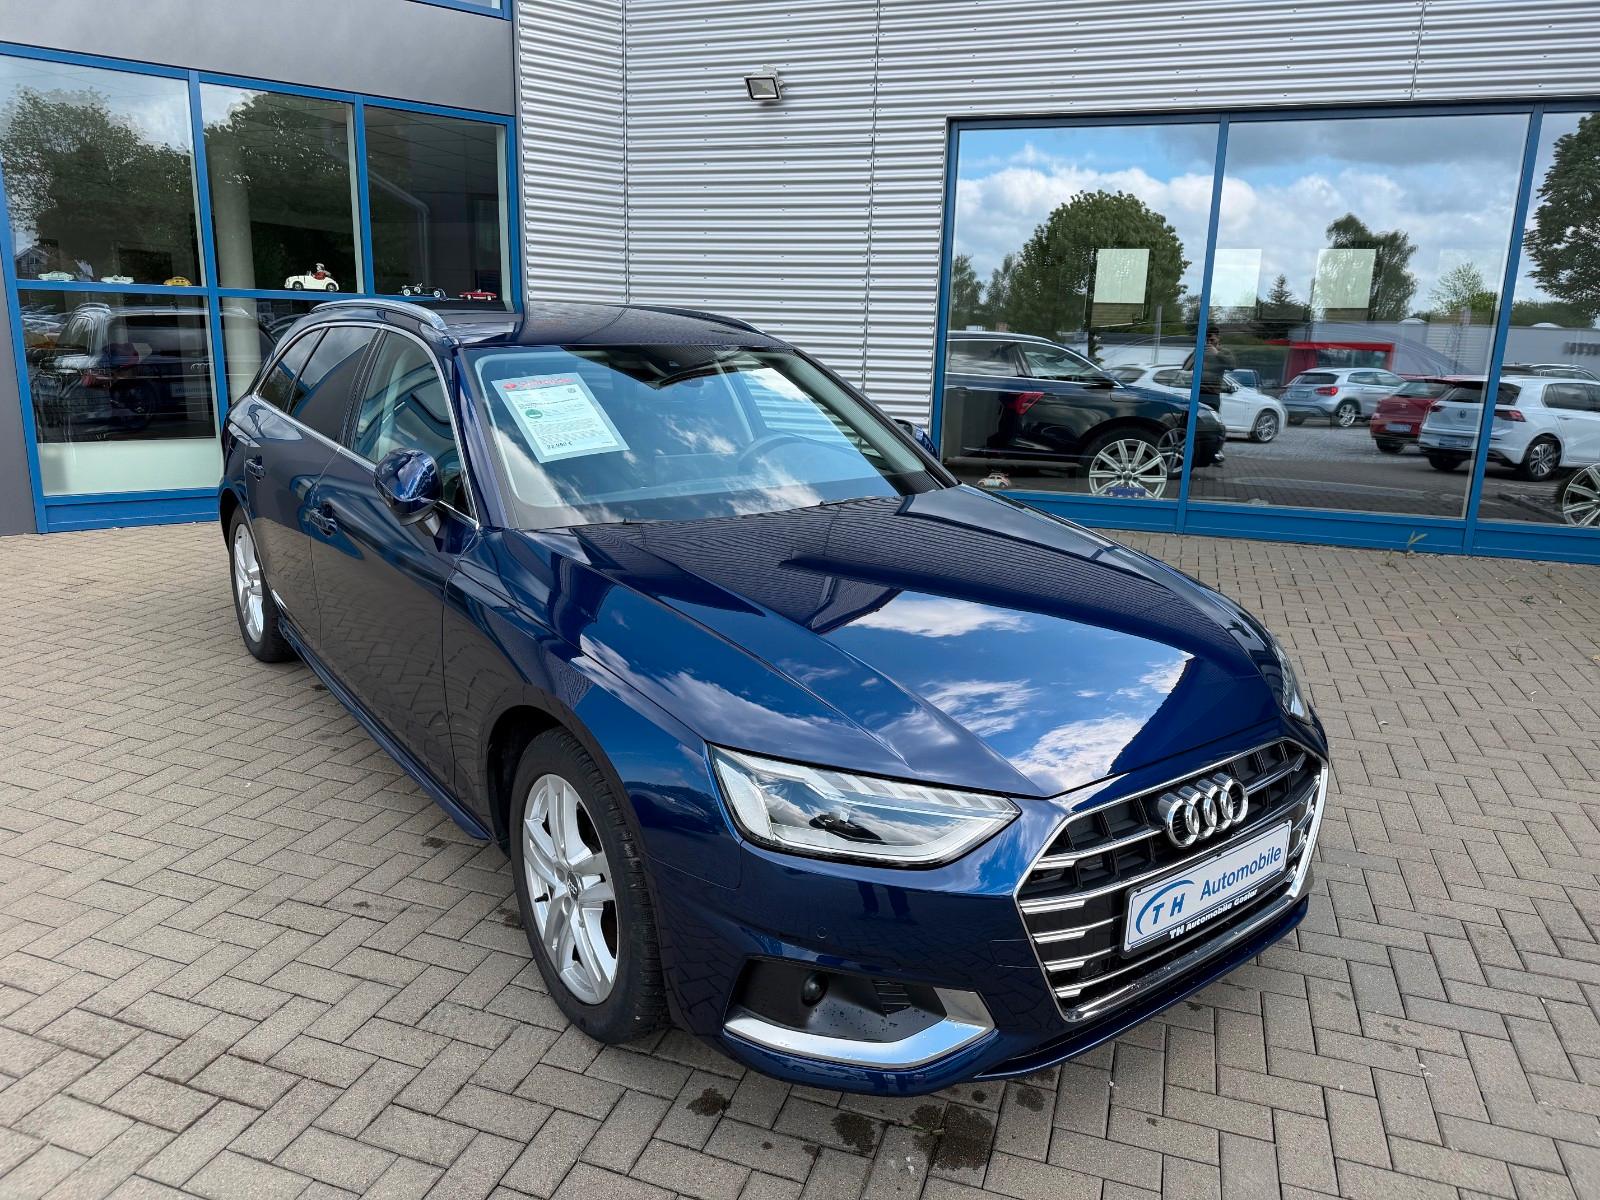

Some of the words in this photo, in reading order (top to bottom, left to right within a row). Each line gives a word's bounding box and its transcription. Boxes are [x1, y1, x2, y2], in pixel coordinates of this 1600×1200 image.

[1200, 846, 1282, 900] Automobile
[1169, 924, 1185, 939] TH
[1185, 902, 1233, 932] Automobile
